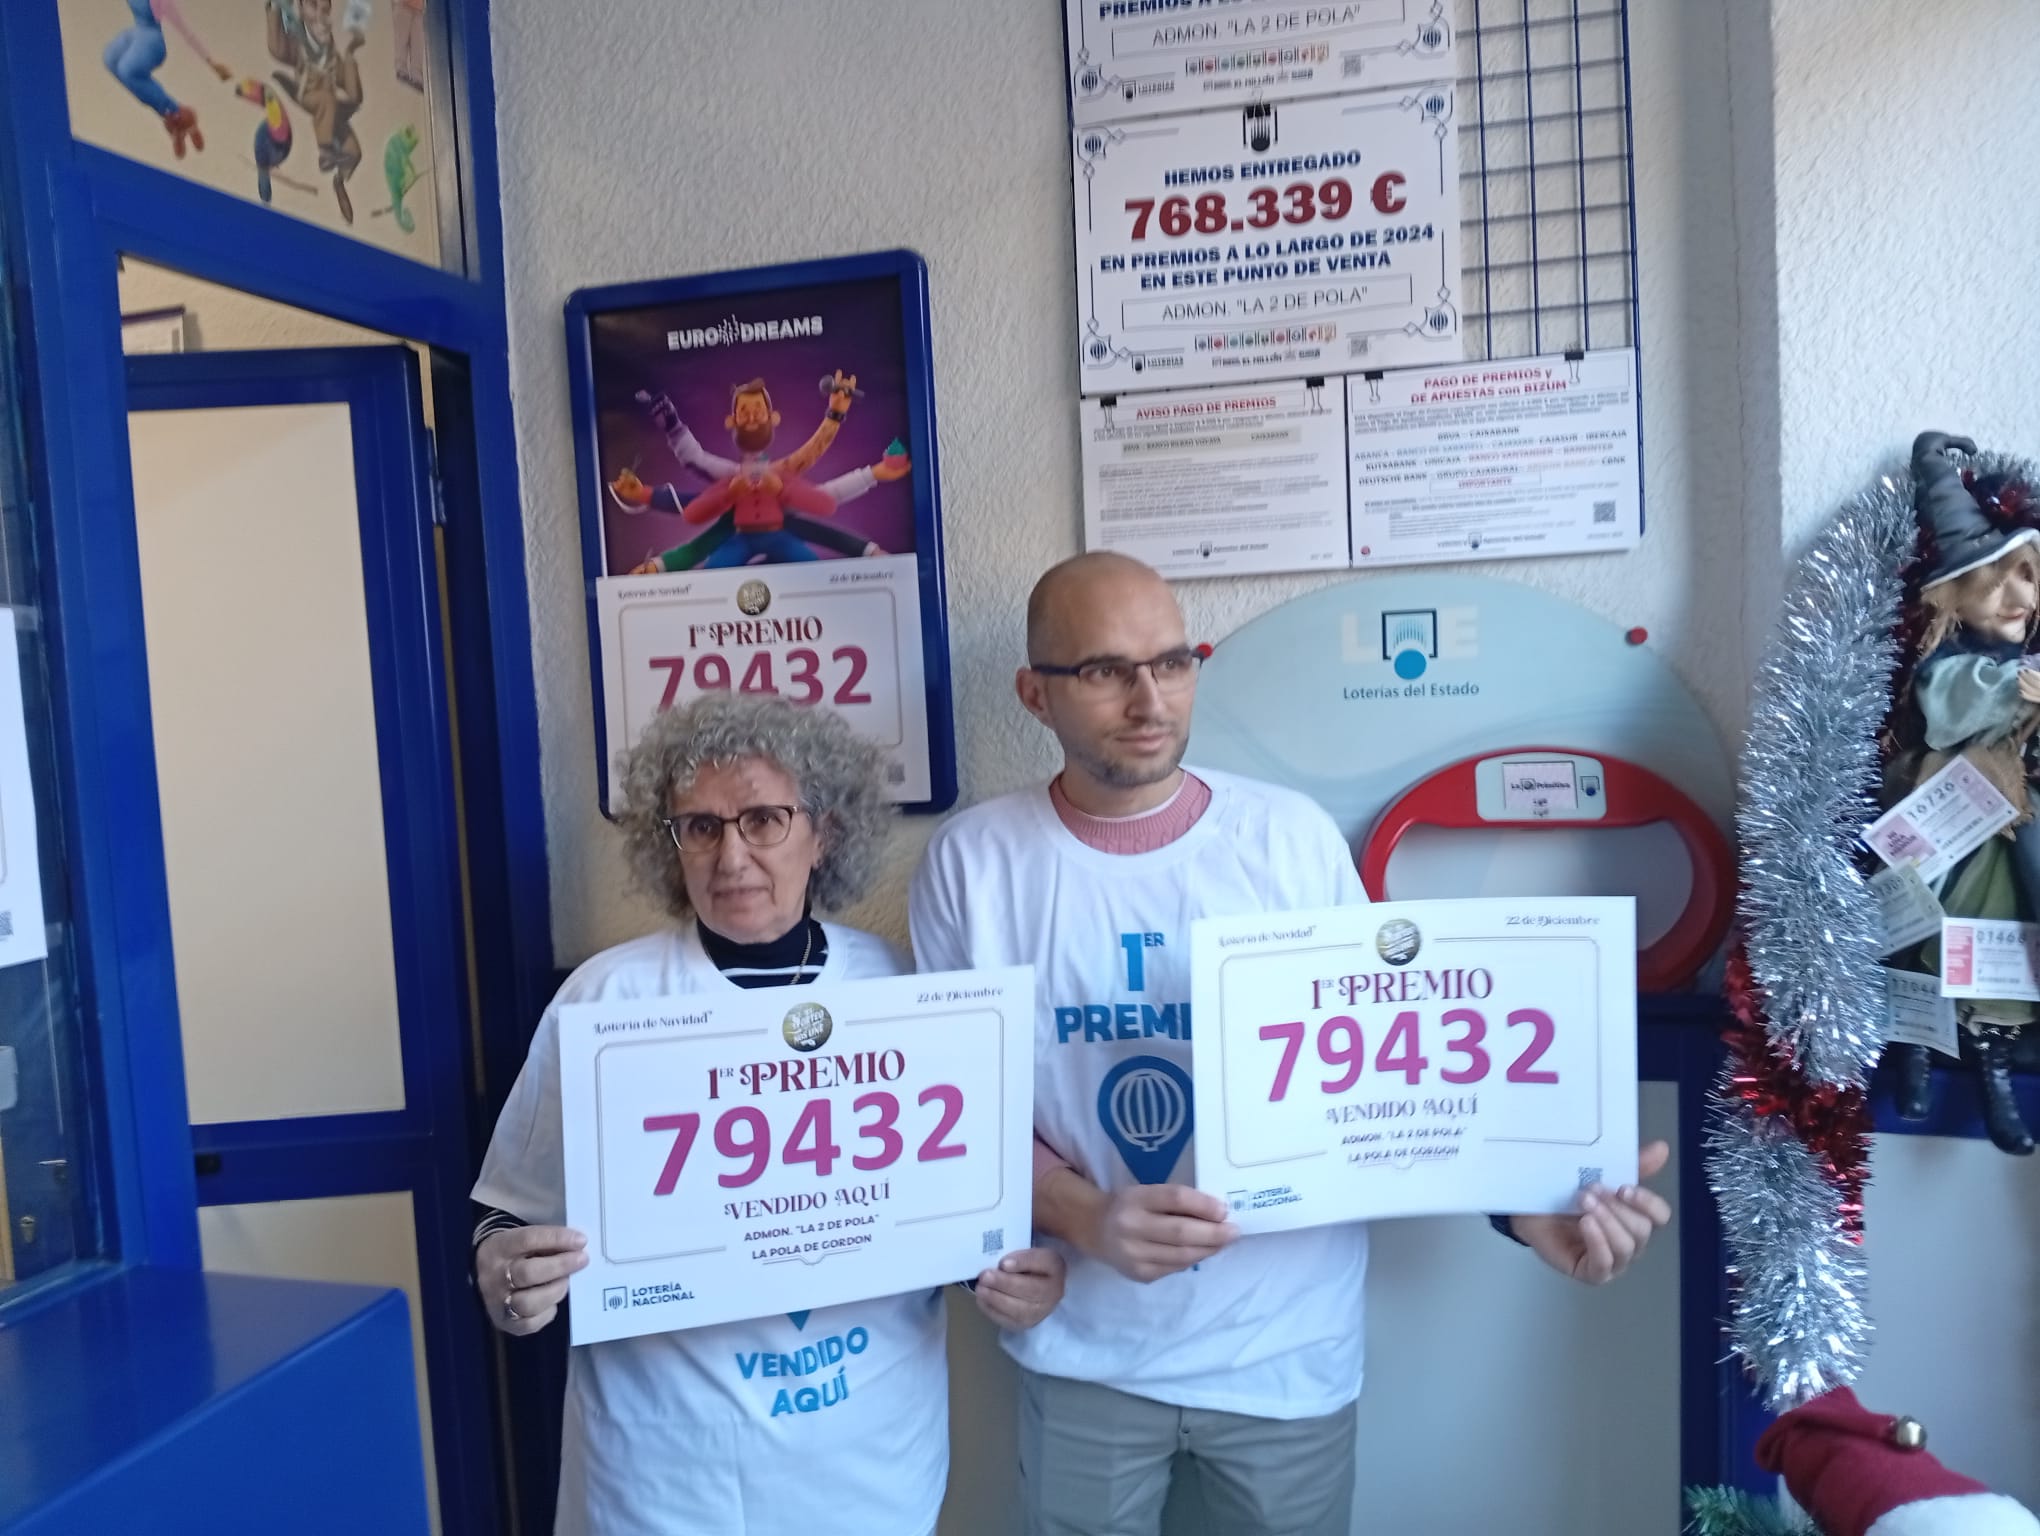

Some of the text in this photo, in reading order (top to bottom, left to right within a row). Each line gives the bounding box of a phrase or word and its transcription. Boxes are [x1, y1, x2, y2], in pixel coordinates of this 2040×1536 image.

[1276, 11, 1300, 32] DE
[1164, 150, 1361, 187] HEMOS ENTREGADO
[1125, 171, 1407, 241] 768.339 €
[1100, 224, 1434, 273] EN PREMIOS A LO LARGO DE 2024
[1141, 251, 1391, 292] EN ESTE PUNTO DE VENTA
[1162, 303, 1228, 322] ADMON.
[1283, 293, 1309, 311] DE
[1313, 286, 1368, 308] POLA"
[1411, 380, 1566, 404] DE APUESTAS con BIZUM
[1424, 376, 1458, 389] PAGO
[1462, 374, 1478, 385] DE
[1482, 368, 1541, 383] PREMIOS
[1137, 397, 1276, 420] AVISO PAGO DE PREMIOS
[709, 615, 823, 647] PREMIO
[649, 644, 872, 713] 79432
[1404, 684, 1425, 697] del
[1431, 681, 1479, 696] Estado
[1506, 915, 1520, 925] 22
[1522, 915, 1536, 925] de
[917, 985, 1004, 1003] 22 de Diciembre
[1338, 967, 1493, 1006] PREMIO
[1054, 1002, 1192, 1044] PREMI
[1259, 1008, 1559, 1102] 79432
[739, 1049, 906, 1096] PREMIO
[1326, 1092, 1478, 1125] VENDIDO AQUÍ
[643, 1084, 968, 1197] 79432
[1416, 1127, 1430, 1138] DE
[1348, 1153, 1362, 1164] LA
[1364, 1149, 1392, 1161] POLA
[1394, 1148, 1408, 1158] DE
[724, 1177, 891, 1220] VENDIDO AQUÍ
[744, 1226, 793, 1242] ADMON.
[818, 1222, 825, 1231] 2
[827, 1219, 842, 1230] DE
[752, 1249, 767, 1260] LA
[770, 1244, 801, 1258] POLA
[804, 1242, 819, 1252] DE
[632, 1291, 695, 1307] NACIONAL
[736, 1326, 869, 1379] VENDIDO
[770, 1365, 849, 1417] AQUÍ
